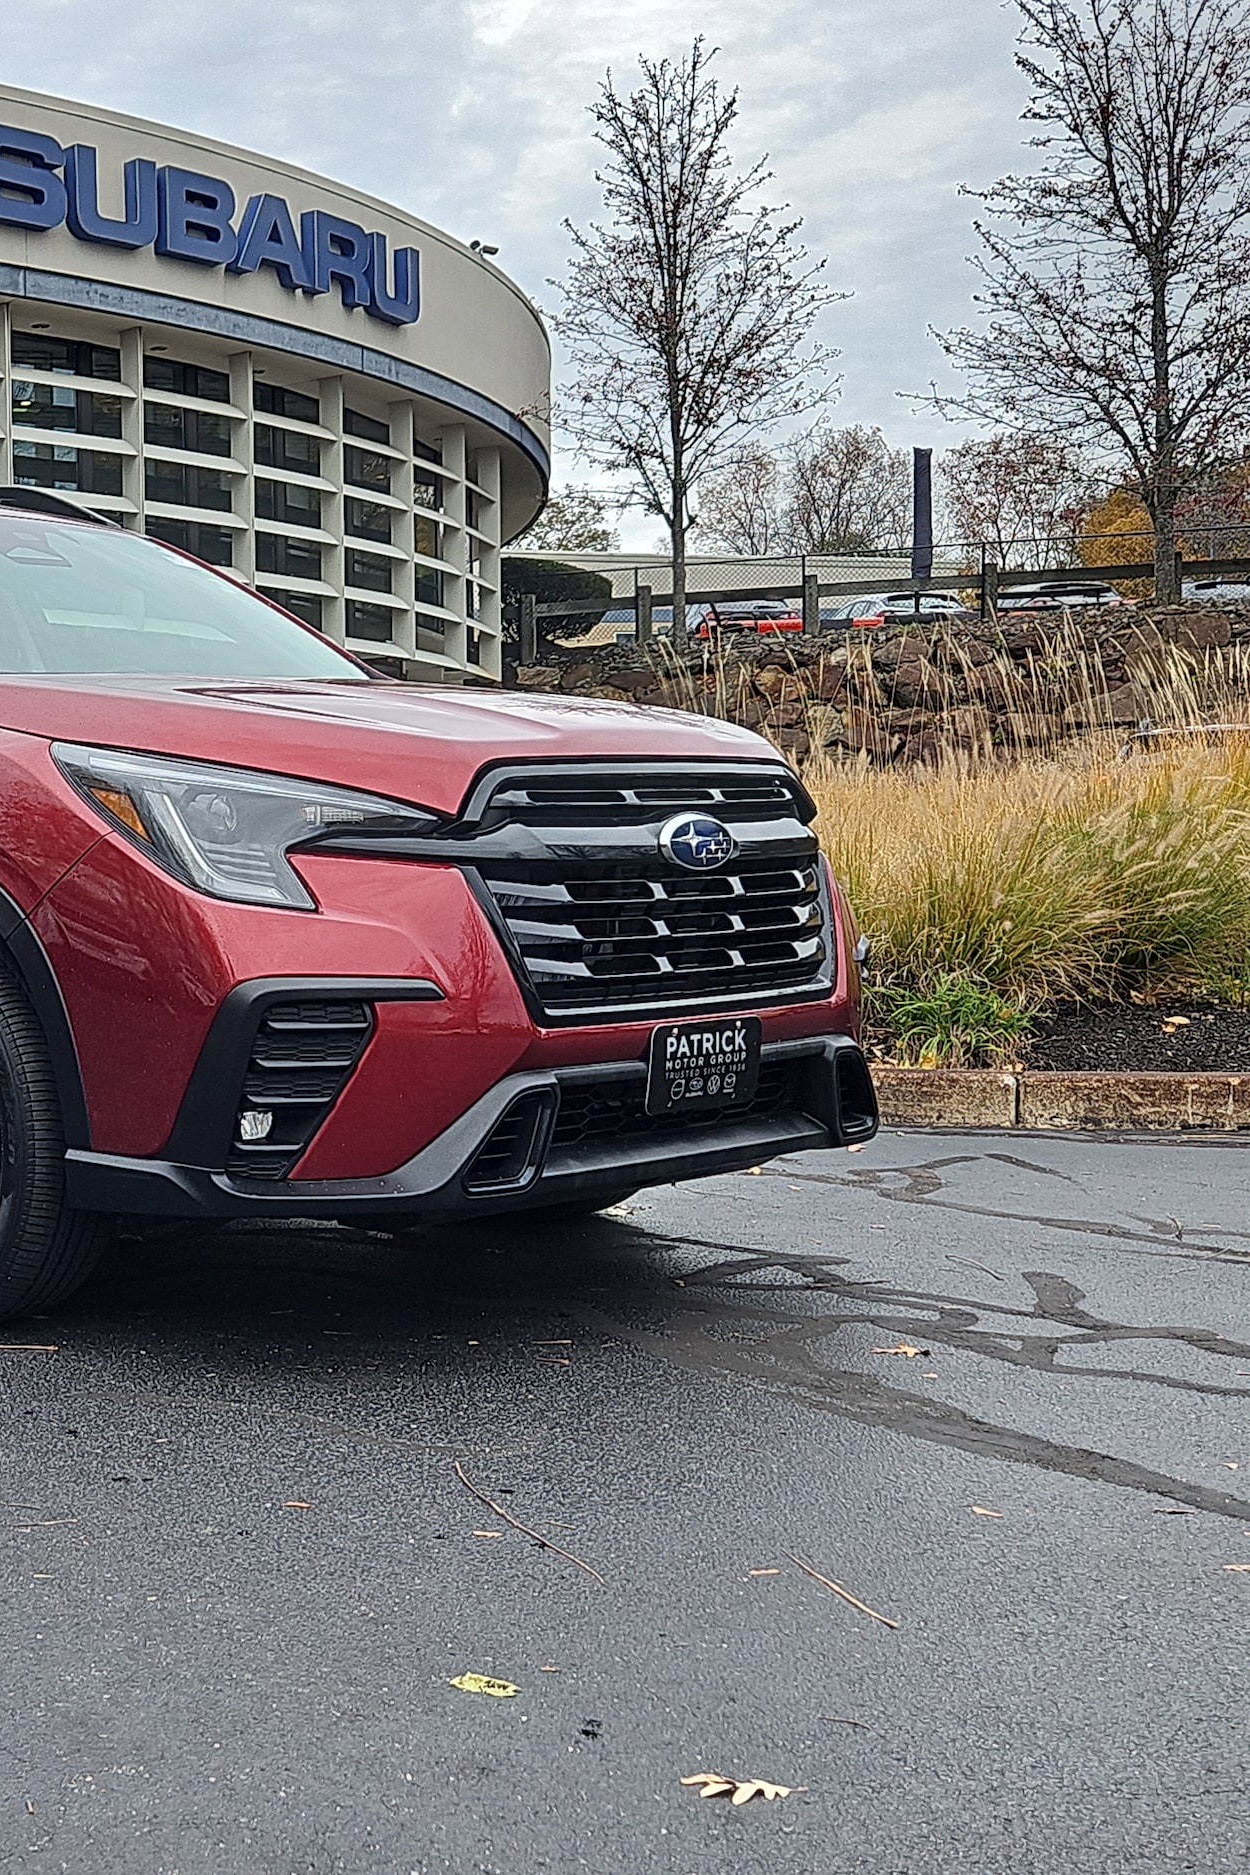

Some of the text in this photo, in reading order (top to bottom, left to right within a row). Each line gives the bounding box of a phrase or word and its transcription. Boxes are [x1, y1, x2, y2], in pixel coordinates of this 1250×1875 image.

[666, 1029, 747, 1059] PATRICK
[665, 1051, 747, 1071] MOTOR GROUP
[665, 1069, 701, 1080] TRUSTED
[703, 1065, 726, 1076] SINCE
